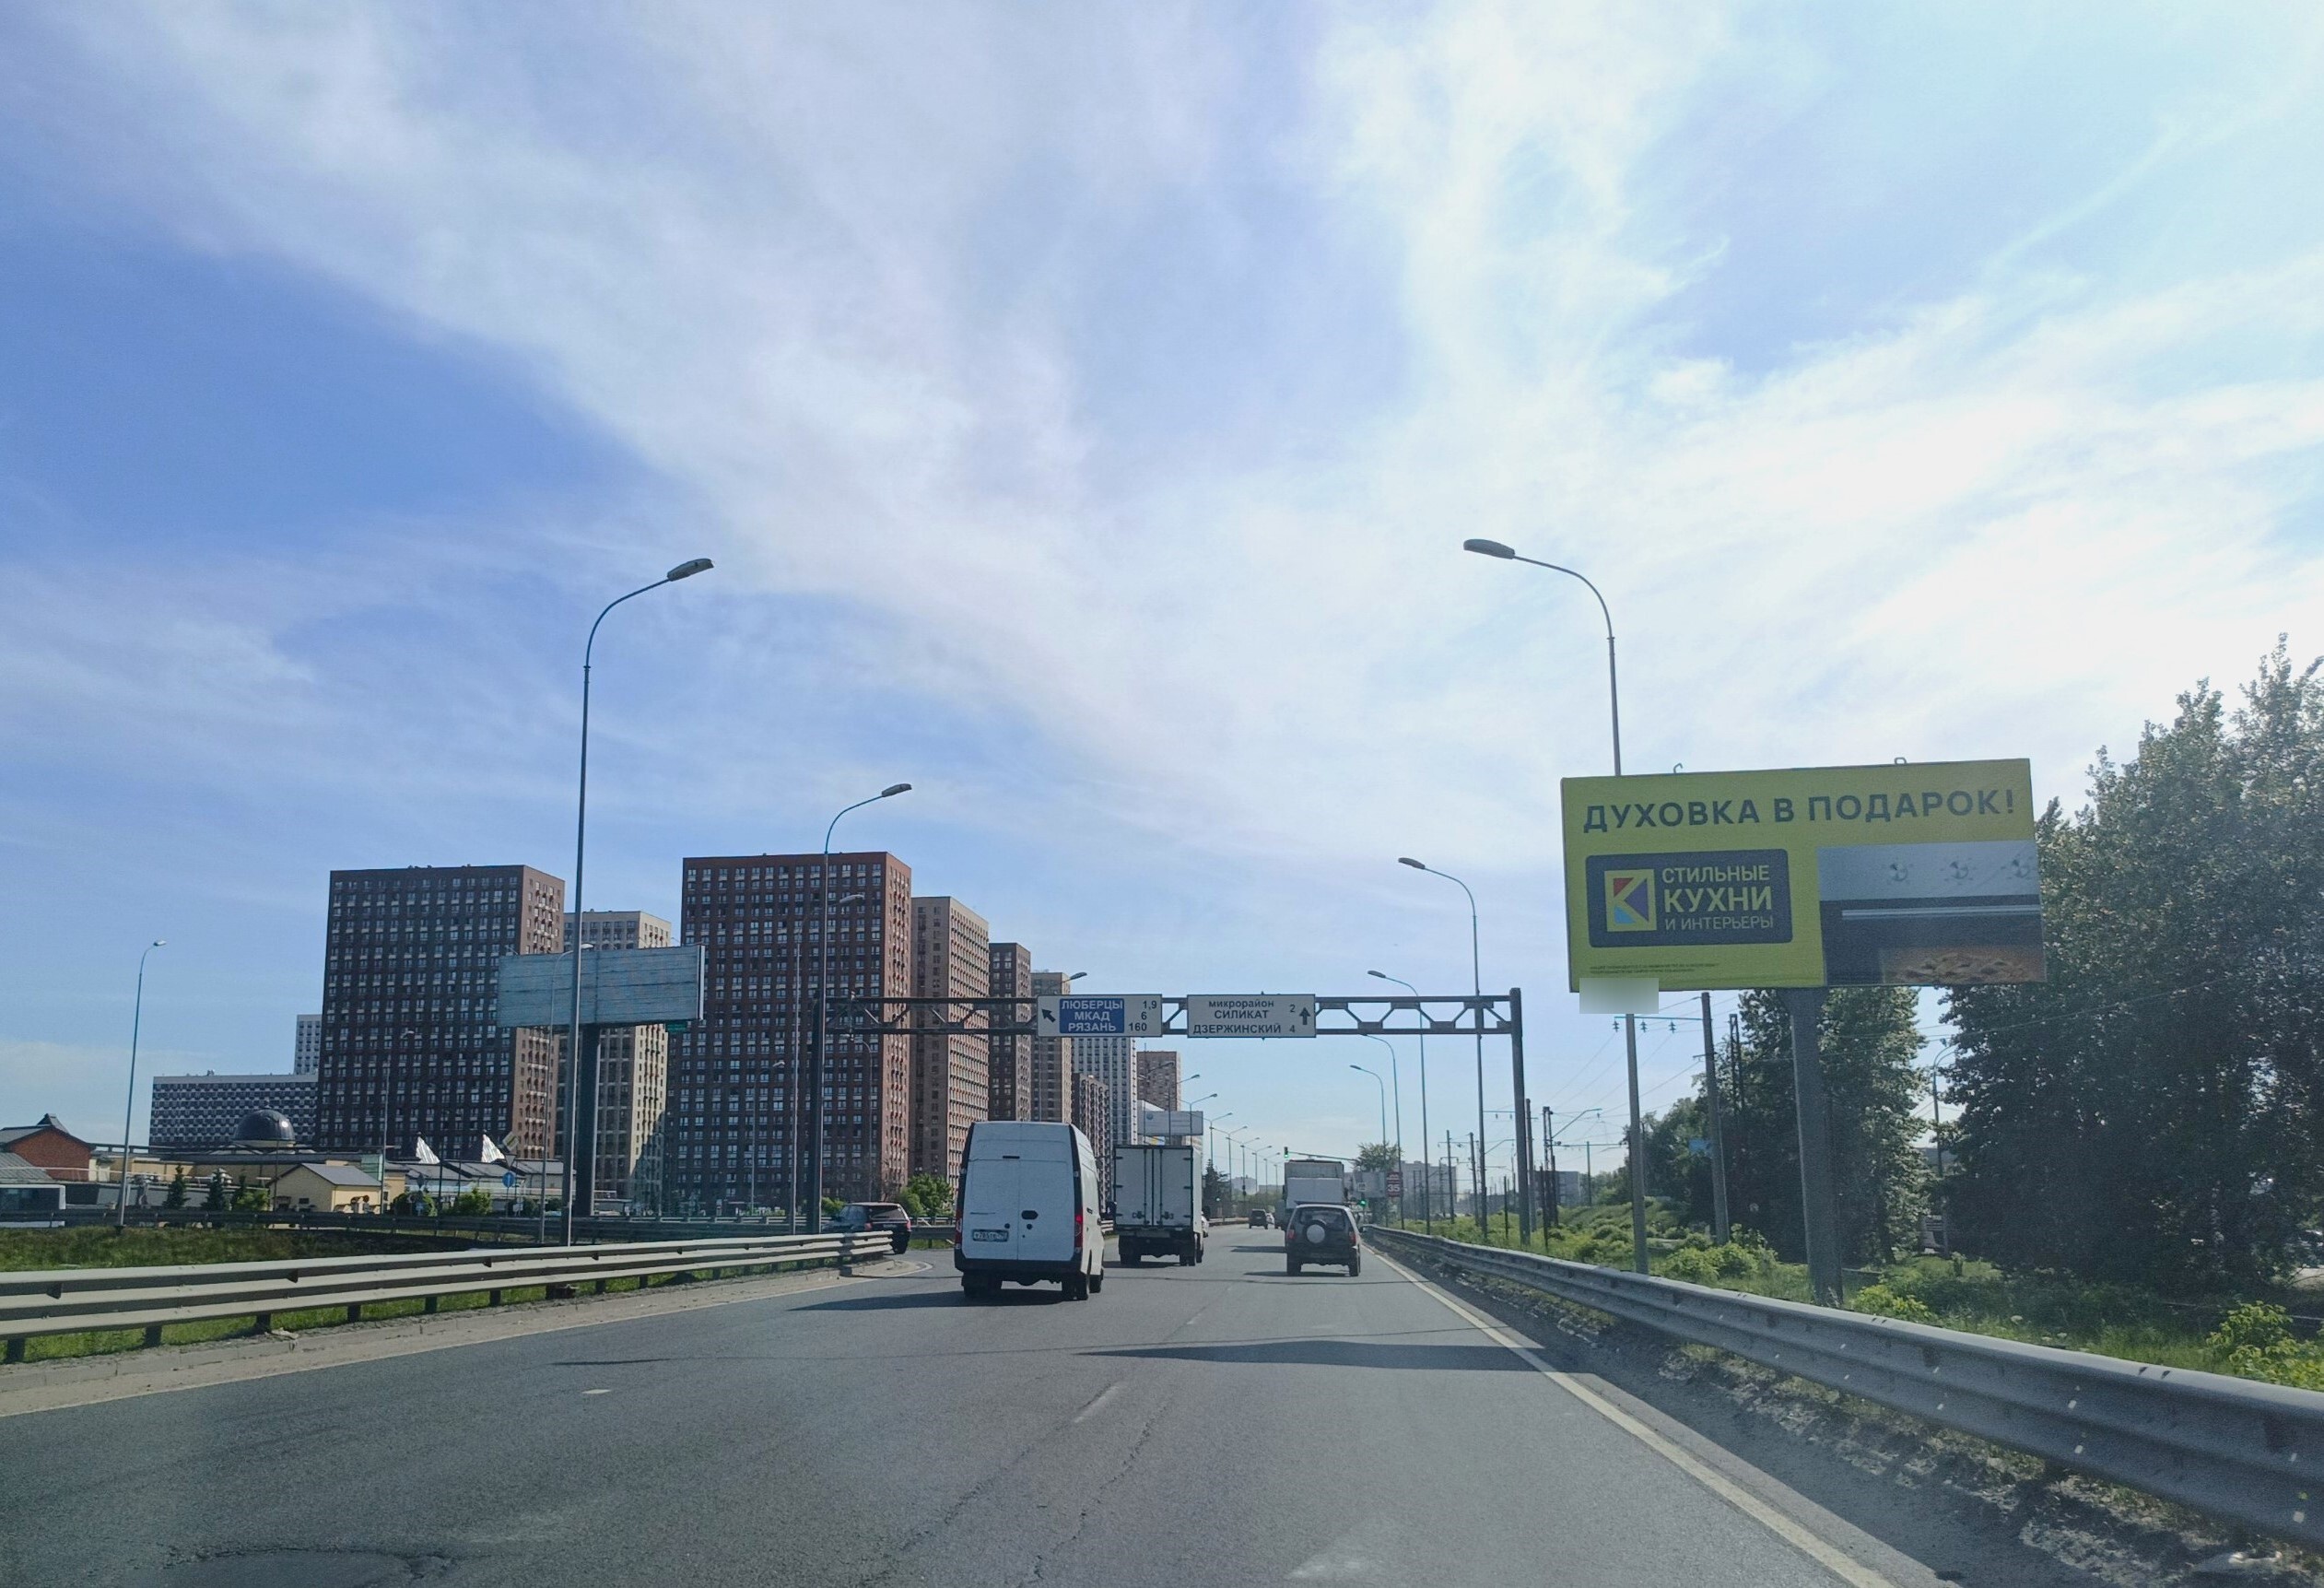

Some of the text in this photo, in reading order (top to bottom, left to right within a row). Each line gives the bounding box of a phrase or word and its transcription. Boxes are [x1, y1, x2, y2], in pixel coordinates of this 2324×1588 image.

[1583, 789, 2013, 833] ДУХОВКА В ПОДАРОК!
[1661, 865, 1770, 884] СТИЛЬНЫЕ
[1664, 886, 1772, 913] КУХНИ
[1665, 915, 1774, 931] И ИНТЕРЬЕРЫ
[1061, 1000, 1157, 1010] ЛЮБЕРЦЫ 1,9
[1208, 999, 1296, 1013] микрорайон 2
[1074, 1011, 1147, 1022] МКАД 6
[1214, 1009, 1270, 1019] СИЛИКАТ
[1068, 1022, 1147, 1032] РЯЗАНЬ 160
[1192, 1022, 1296, 1034] ДЗЕРЖИНСКИЙ 4
